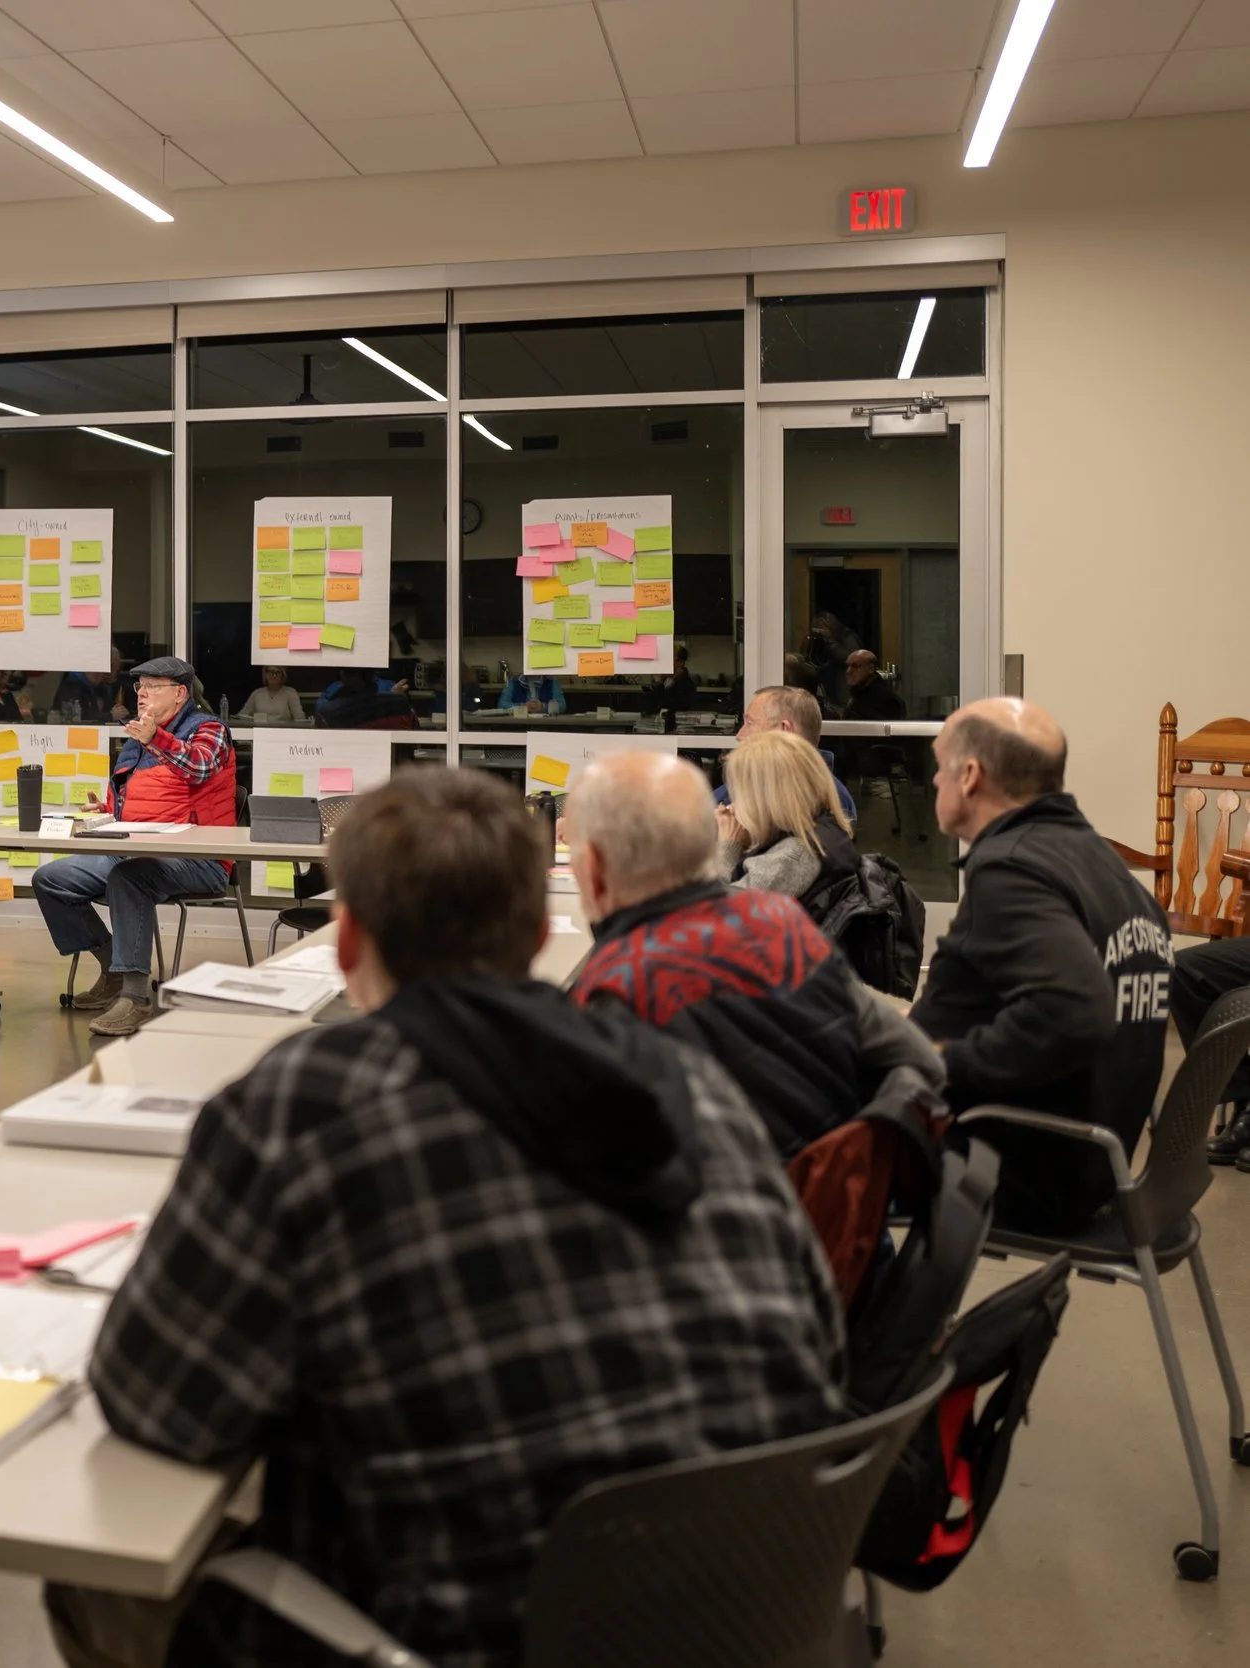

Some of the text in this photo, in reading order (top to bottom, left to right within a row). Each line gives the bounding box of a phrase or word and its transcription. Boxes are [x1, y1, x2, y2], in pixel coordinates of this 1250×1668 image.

[851, 188, 907, 231] EXIT
[30, 733, 54, 754] High
[288, 743, 325, 757] Medium
[1100, 919, 1135, 970] AKE
[1115, 972, 1170, 1022] FIRE
